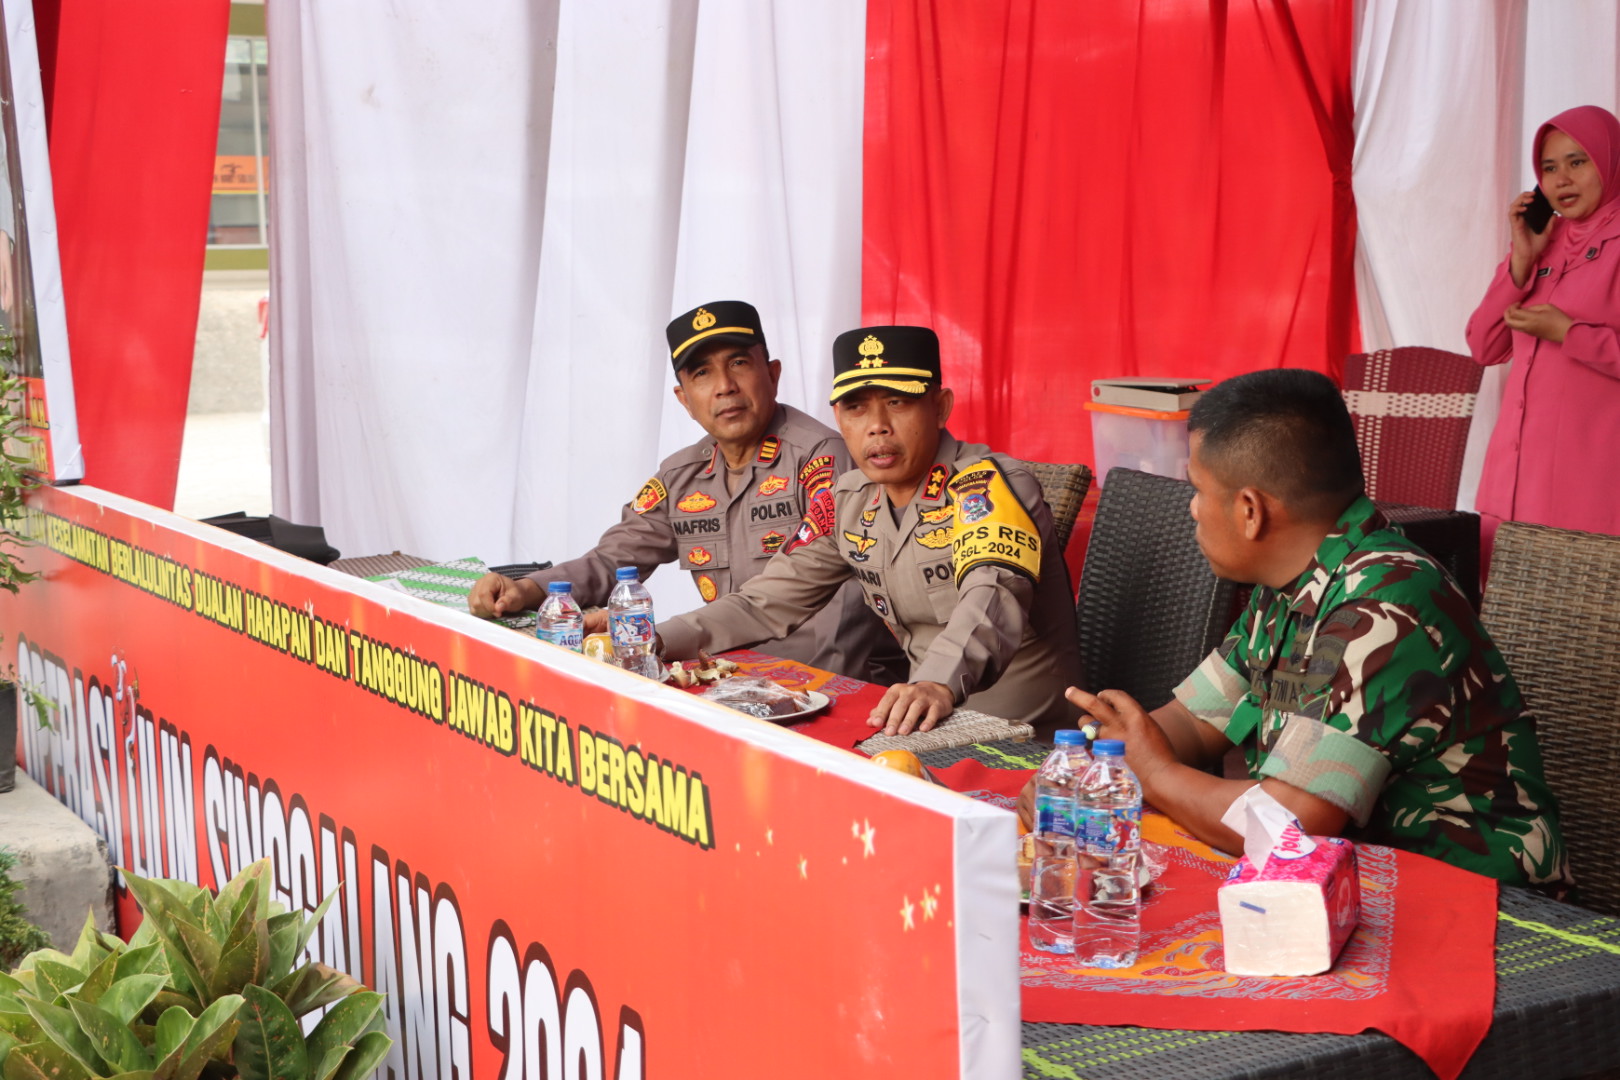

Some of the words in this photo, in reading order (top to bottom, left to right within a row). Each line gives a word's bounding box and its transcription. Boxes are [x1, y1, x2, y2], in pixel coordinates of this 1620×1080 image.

[751, 501, 793, 522] POLRI
[673, 518, 721, 536] NAFRIS
[953, 526, 989, 555] OPS
[999, 525, 1038, 551] RES
[46, 511, 112, 576] KESELAMATAN
[110, 536, 193, 612] BERLALULINTAS
[194, 567, 244, 634] DIJALAN
[245, 589, 313, 664] HARAPAN
[313, 616, 350, 680] DAN
[349, 629, 447, 725] TANGGUNG
[447, 670, 517, 757] JAWAB
[518, 698, 579, 787] KITA
[577, 723, 717, 851] BERSAMA
